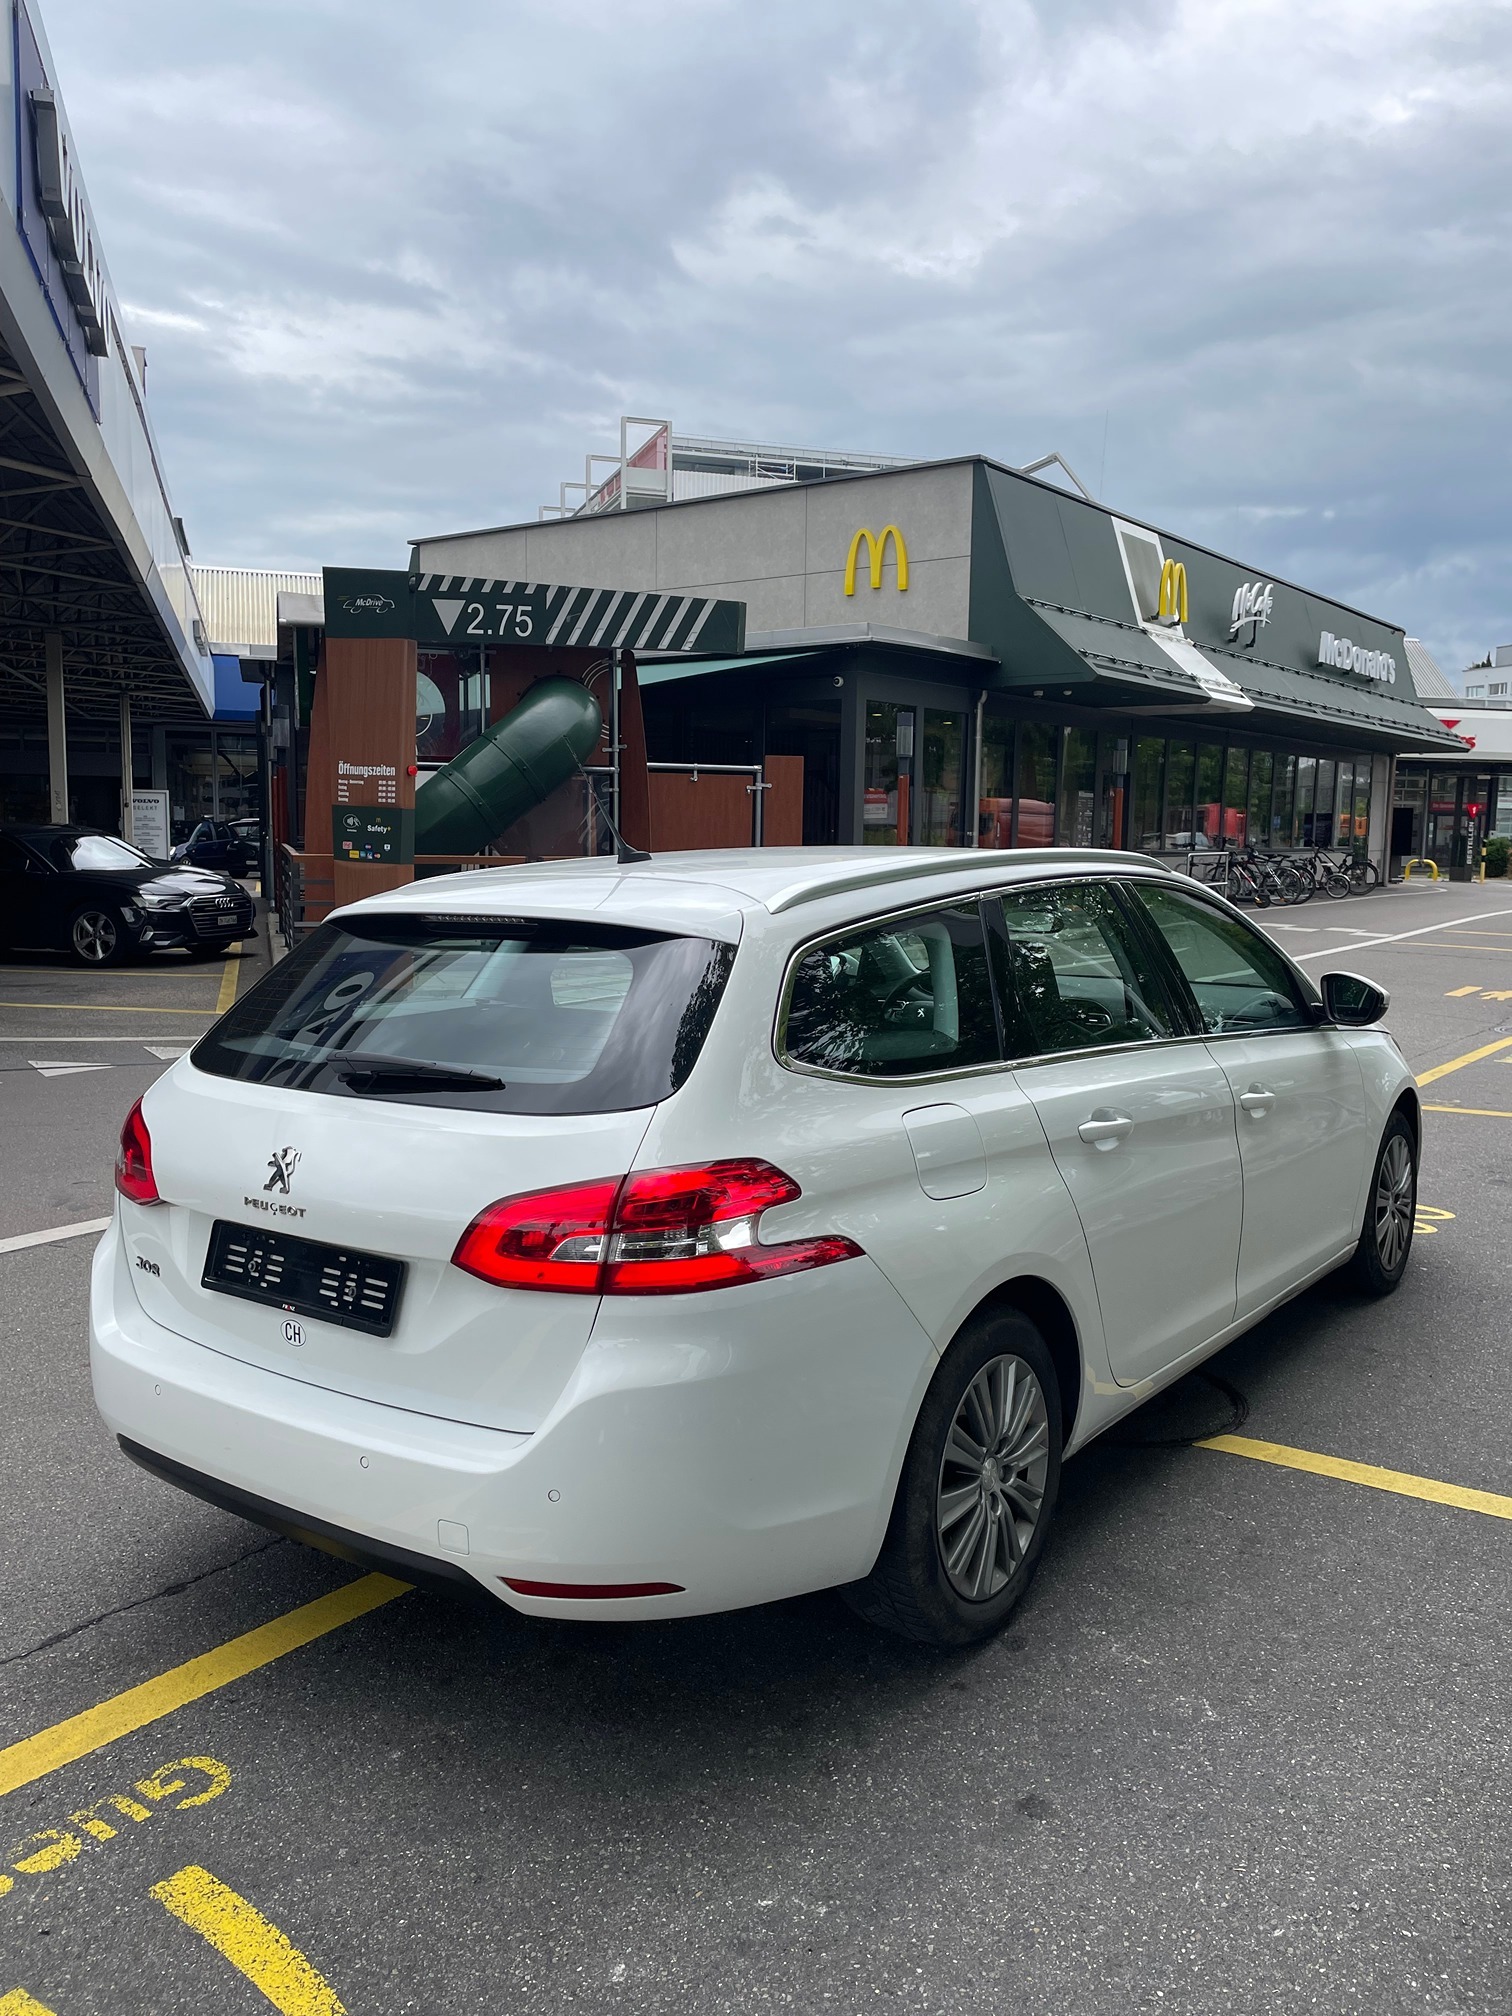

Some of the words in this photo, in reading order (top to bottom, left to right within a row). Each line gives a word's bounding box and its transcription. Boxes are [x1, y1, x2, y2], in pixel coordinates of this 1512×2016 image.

[32, 88, 111, 358] VOLVO
[355, 598, 384, 606] McDrive
[466, 603, 533, 637] 2.75
[1318, 630, 1396, 684] McDonald's
[338, 760, 396, 778] Öffnungszeiten
[1466, 821, 1475, 865] BESTELLEN
[244, 1196, 307, 1218] PEUGEOT
[135, 1256, 161, 1278] 308
[285, 1322, 301, 1344] CH
